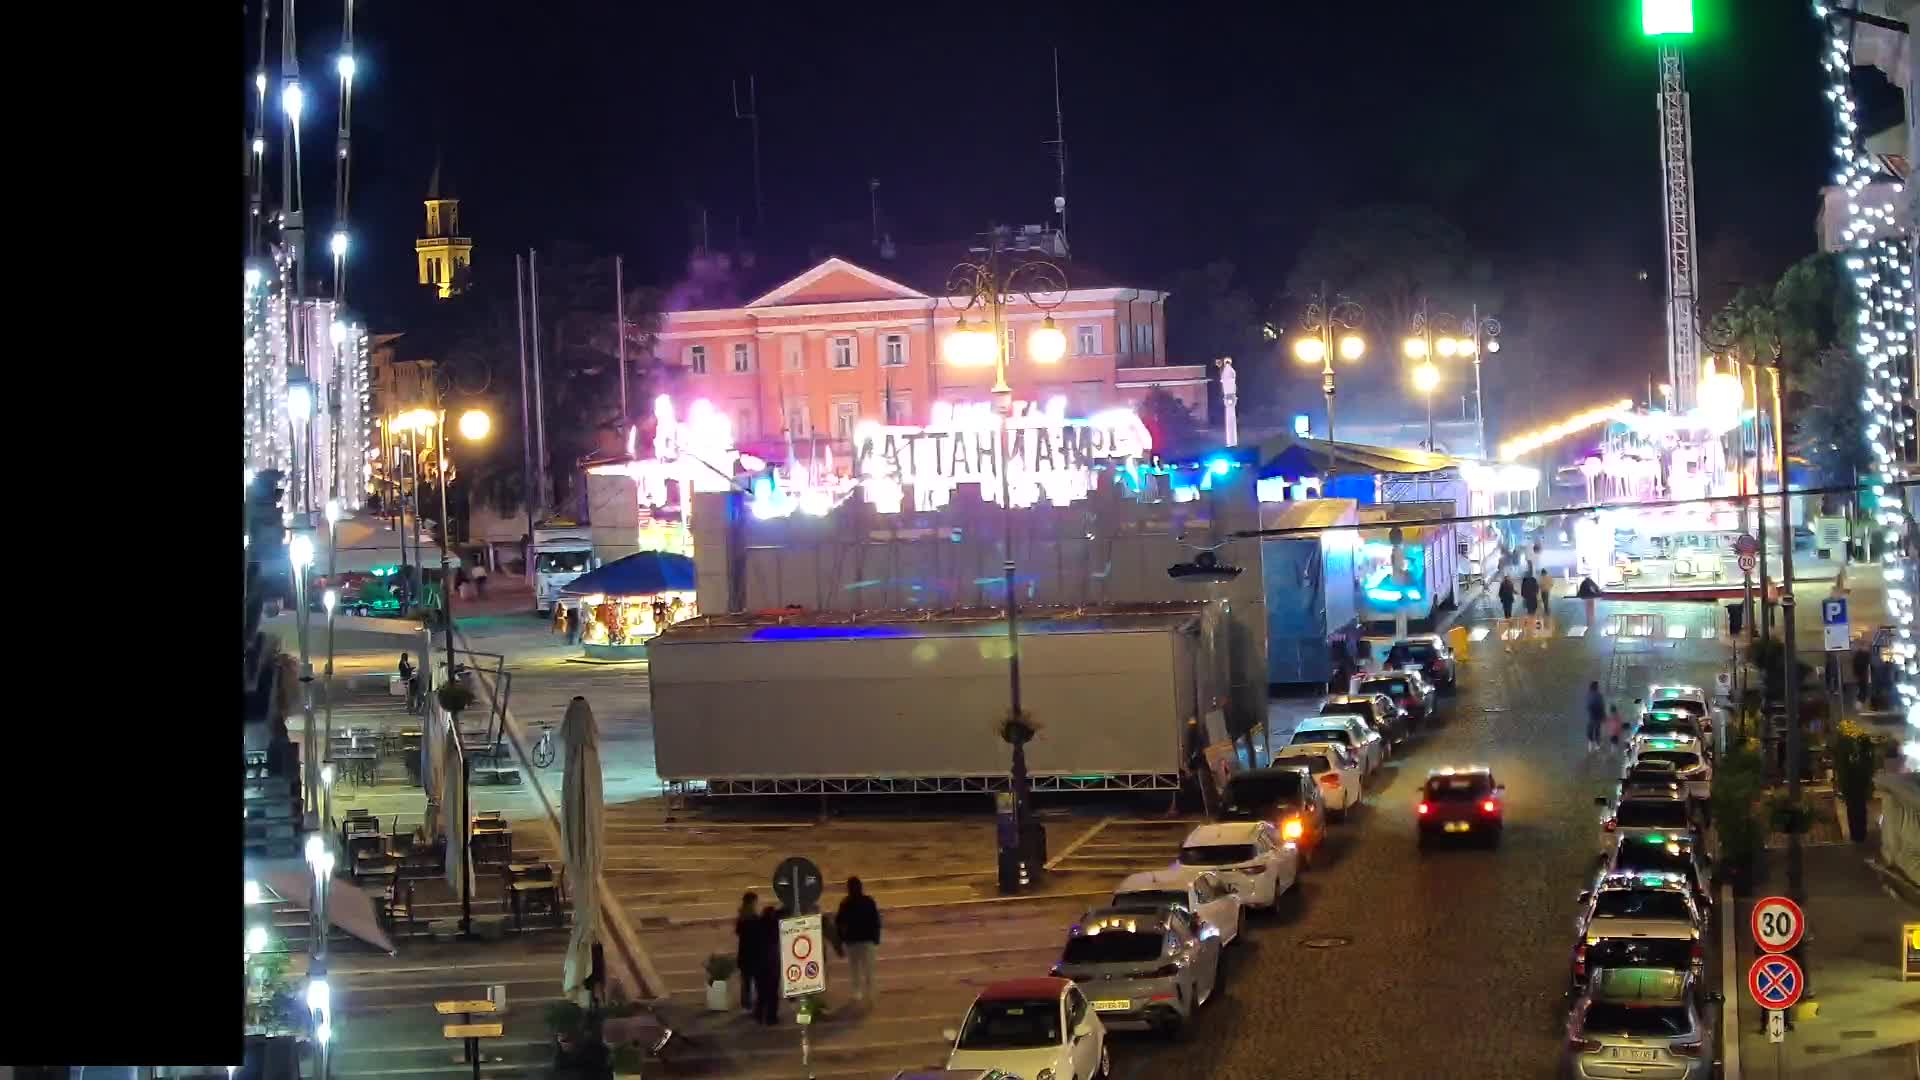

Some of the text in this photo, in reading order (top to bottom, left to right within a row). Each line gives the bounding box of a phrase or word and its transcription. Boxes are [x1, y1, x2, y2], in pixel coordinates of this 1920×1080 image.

[1742, 558, 1752, 567] 20
[1825, 602, 1841, 621] P
[1762, 912, 1791, 938] 30
